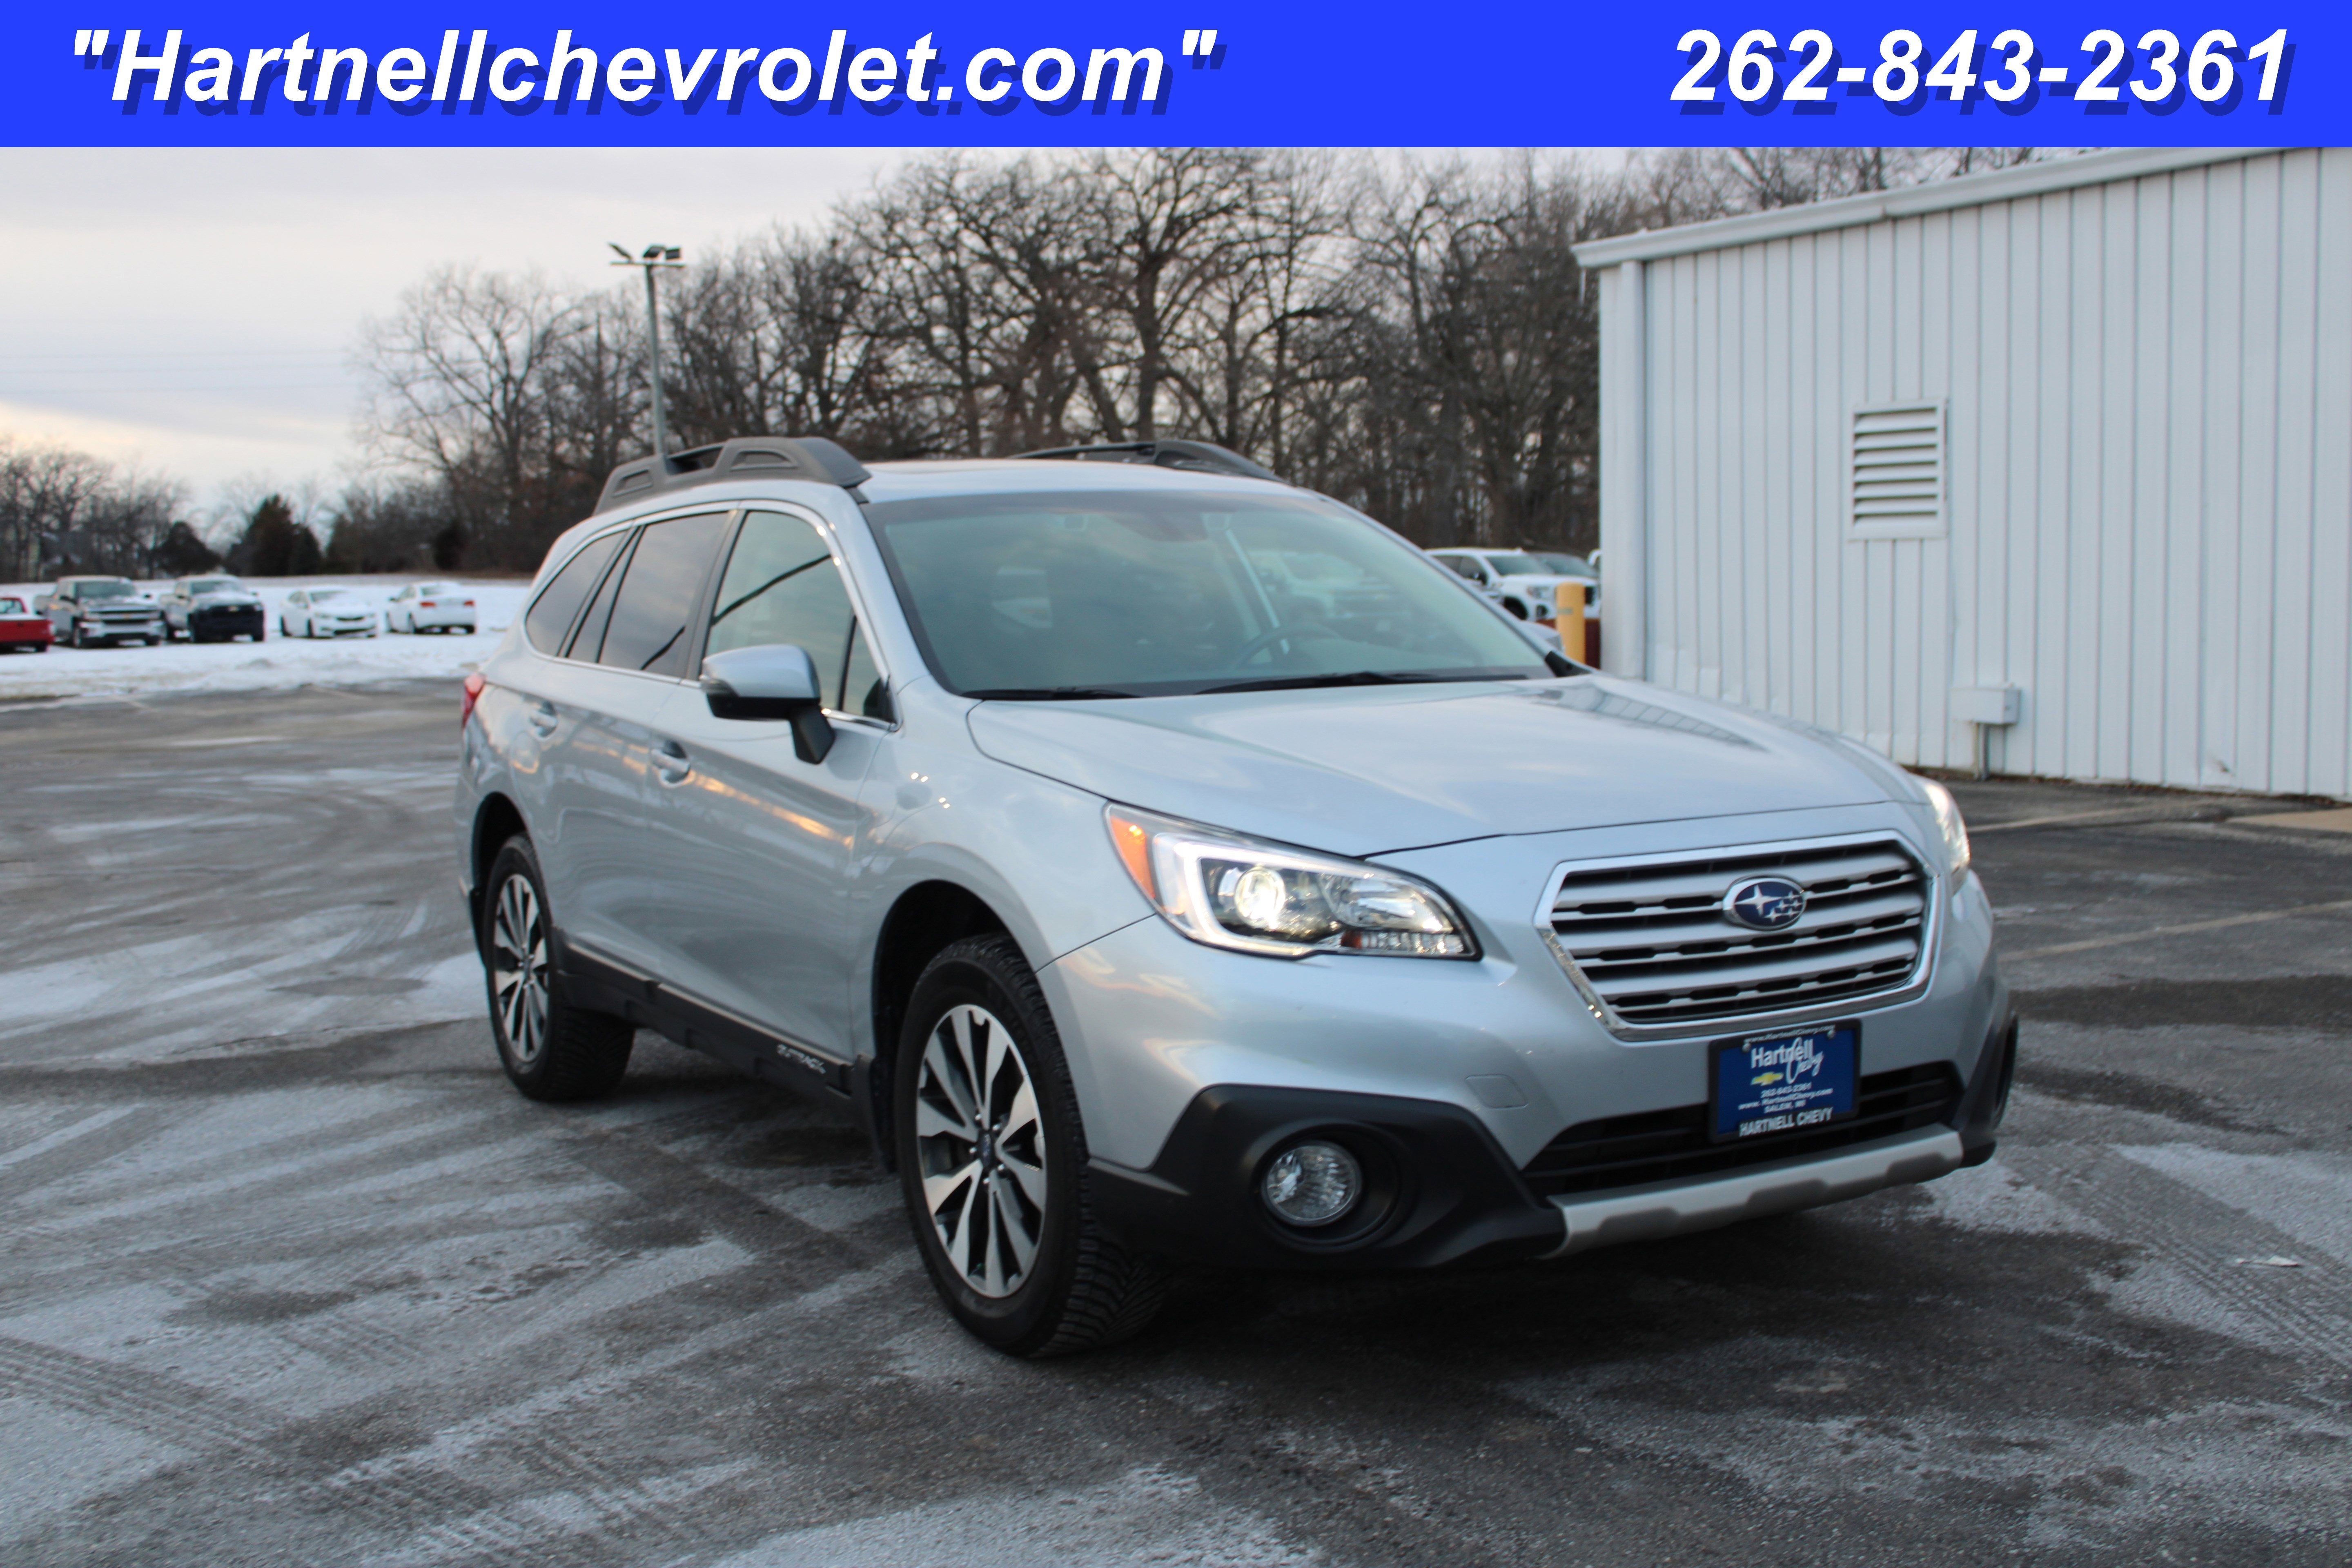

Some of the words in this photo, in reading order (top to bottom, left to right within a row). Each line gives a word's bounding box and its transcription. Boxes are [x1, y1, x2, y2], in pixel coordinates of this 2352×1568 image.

[1751, 1038, 1814, 1069] Hartnell
[1739, 1114, 1795, 1137] HARTNELL
[1796, 1107, 1833, 1126] CHEVY
